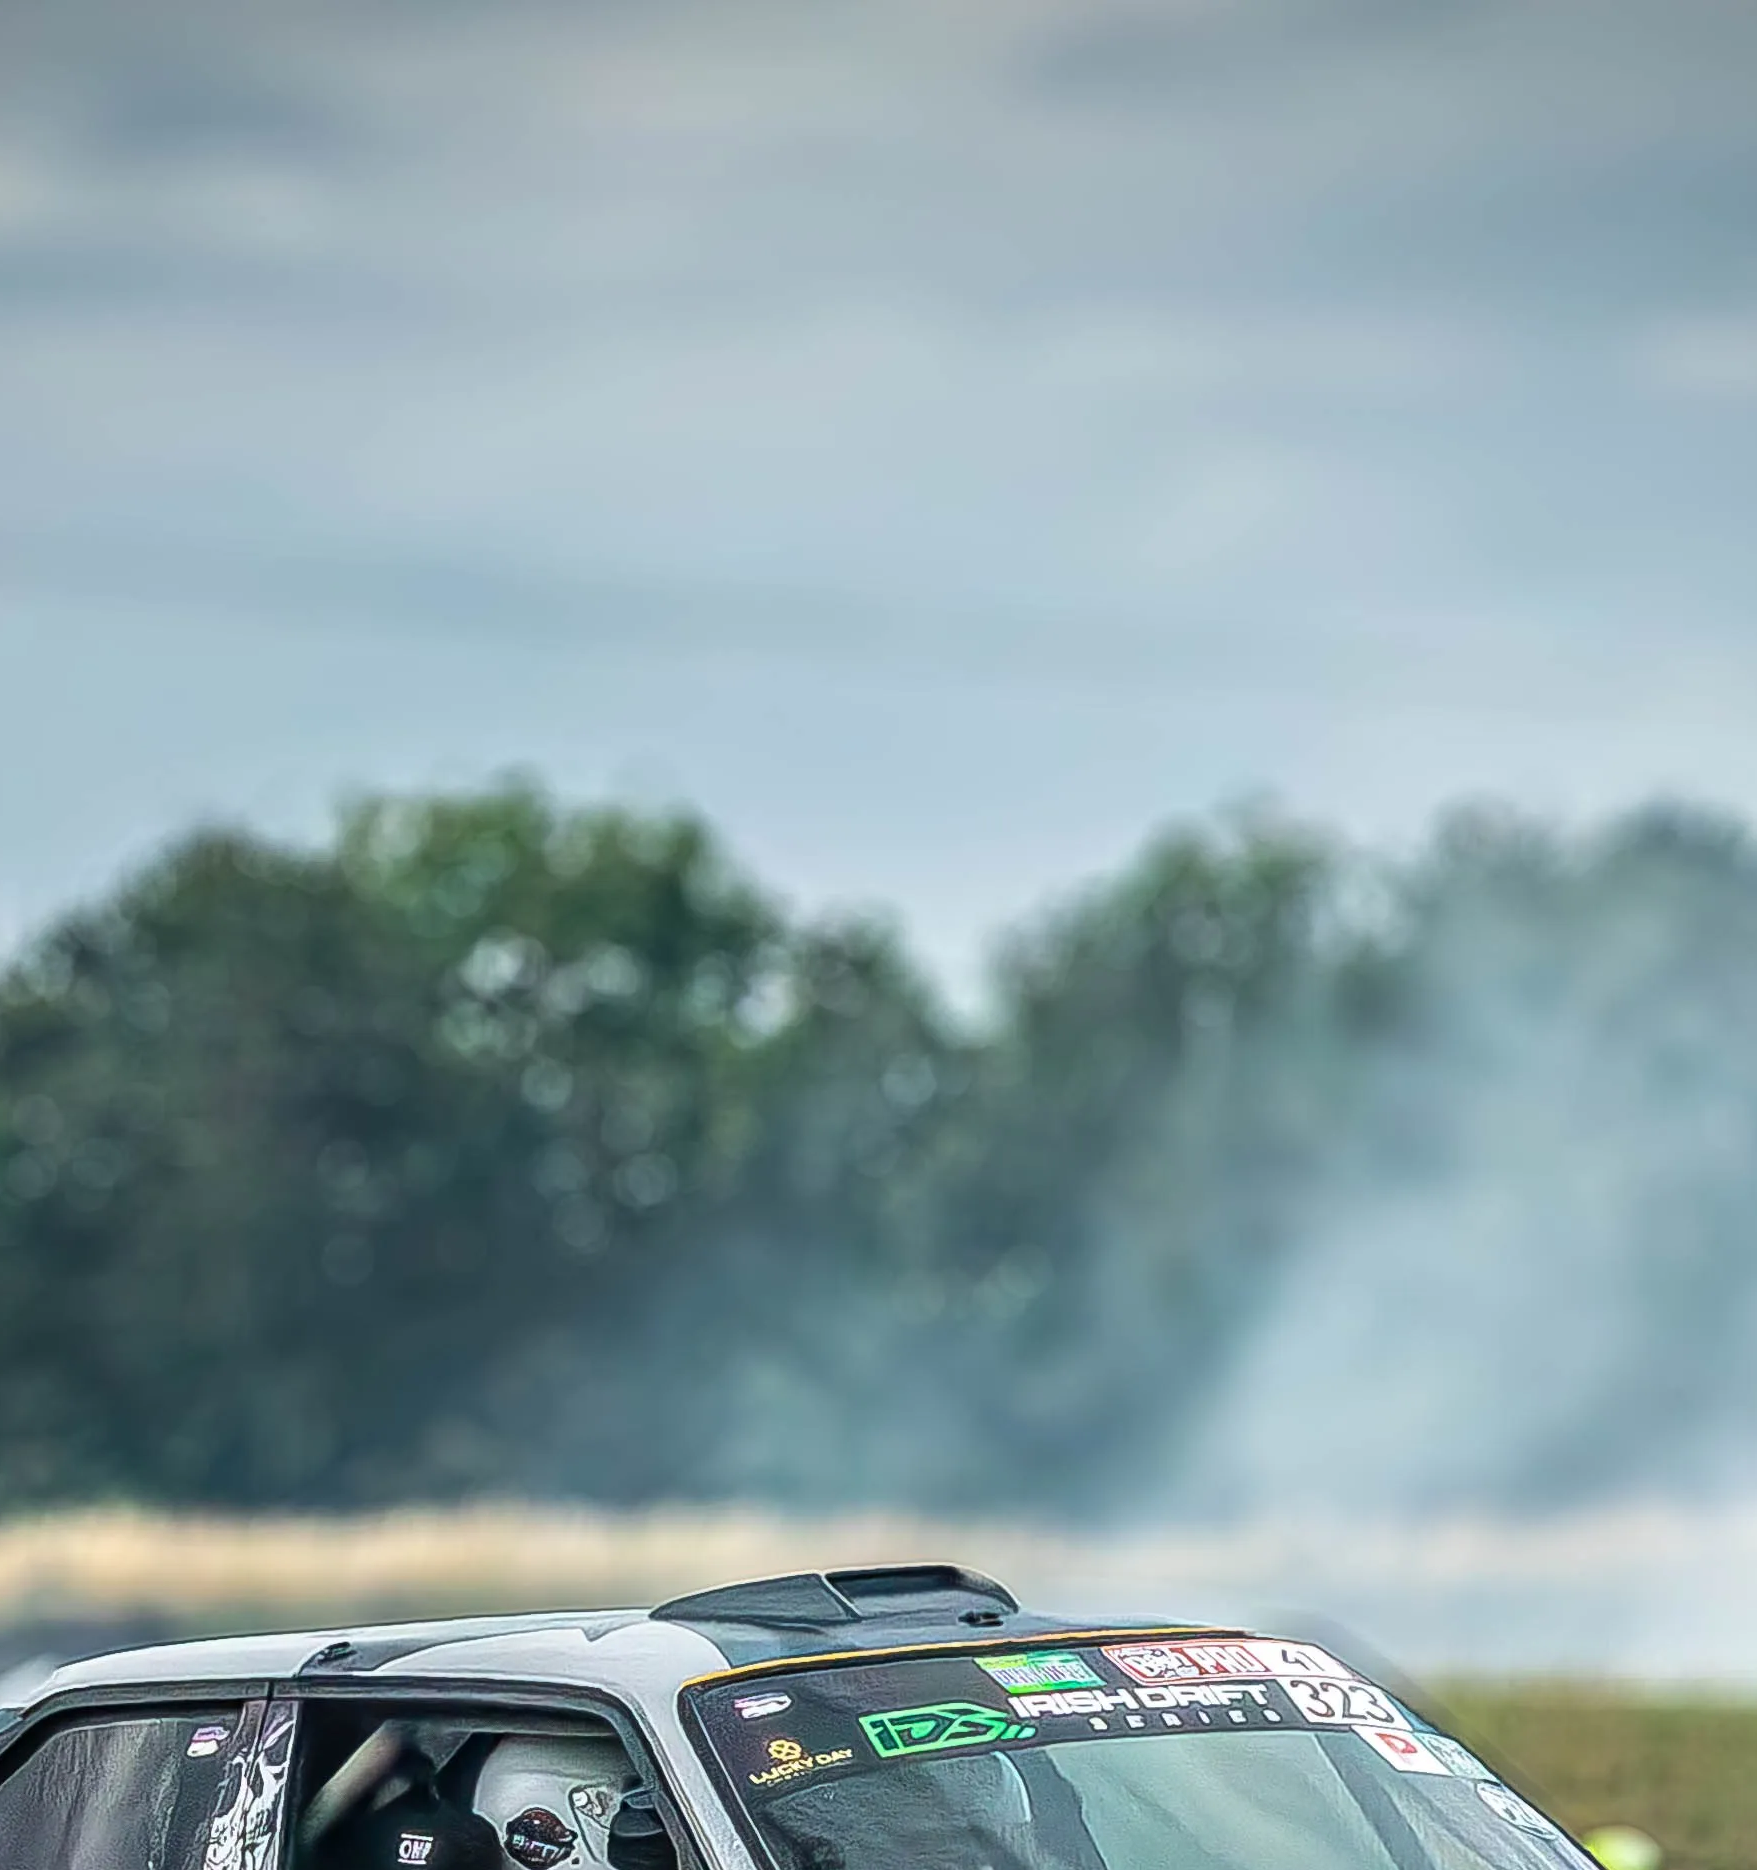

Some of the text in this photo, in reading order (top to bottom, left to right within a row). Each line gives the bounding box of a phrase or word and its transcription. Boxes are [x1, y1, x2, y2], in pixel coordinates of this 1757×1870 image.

[1007, 1683, 1269, 1719] IRISH DRIFT
[1290, 1679, 1395, 1723] 323
[748, 1756, 814, 1785] LUCKY
[815, 1748, 853, 1765] DAY
